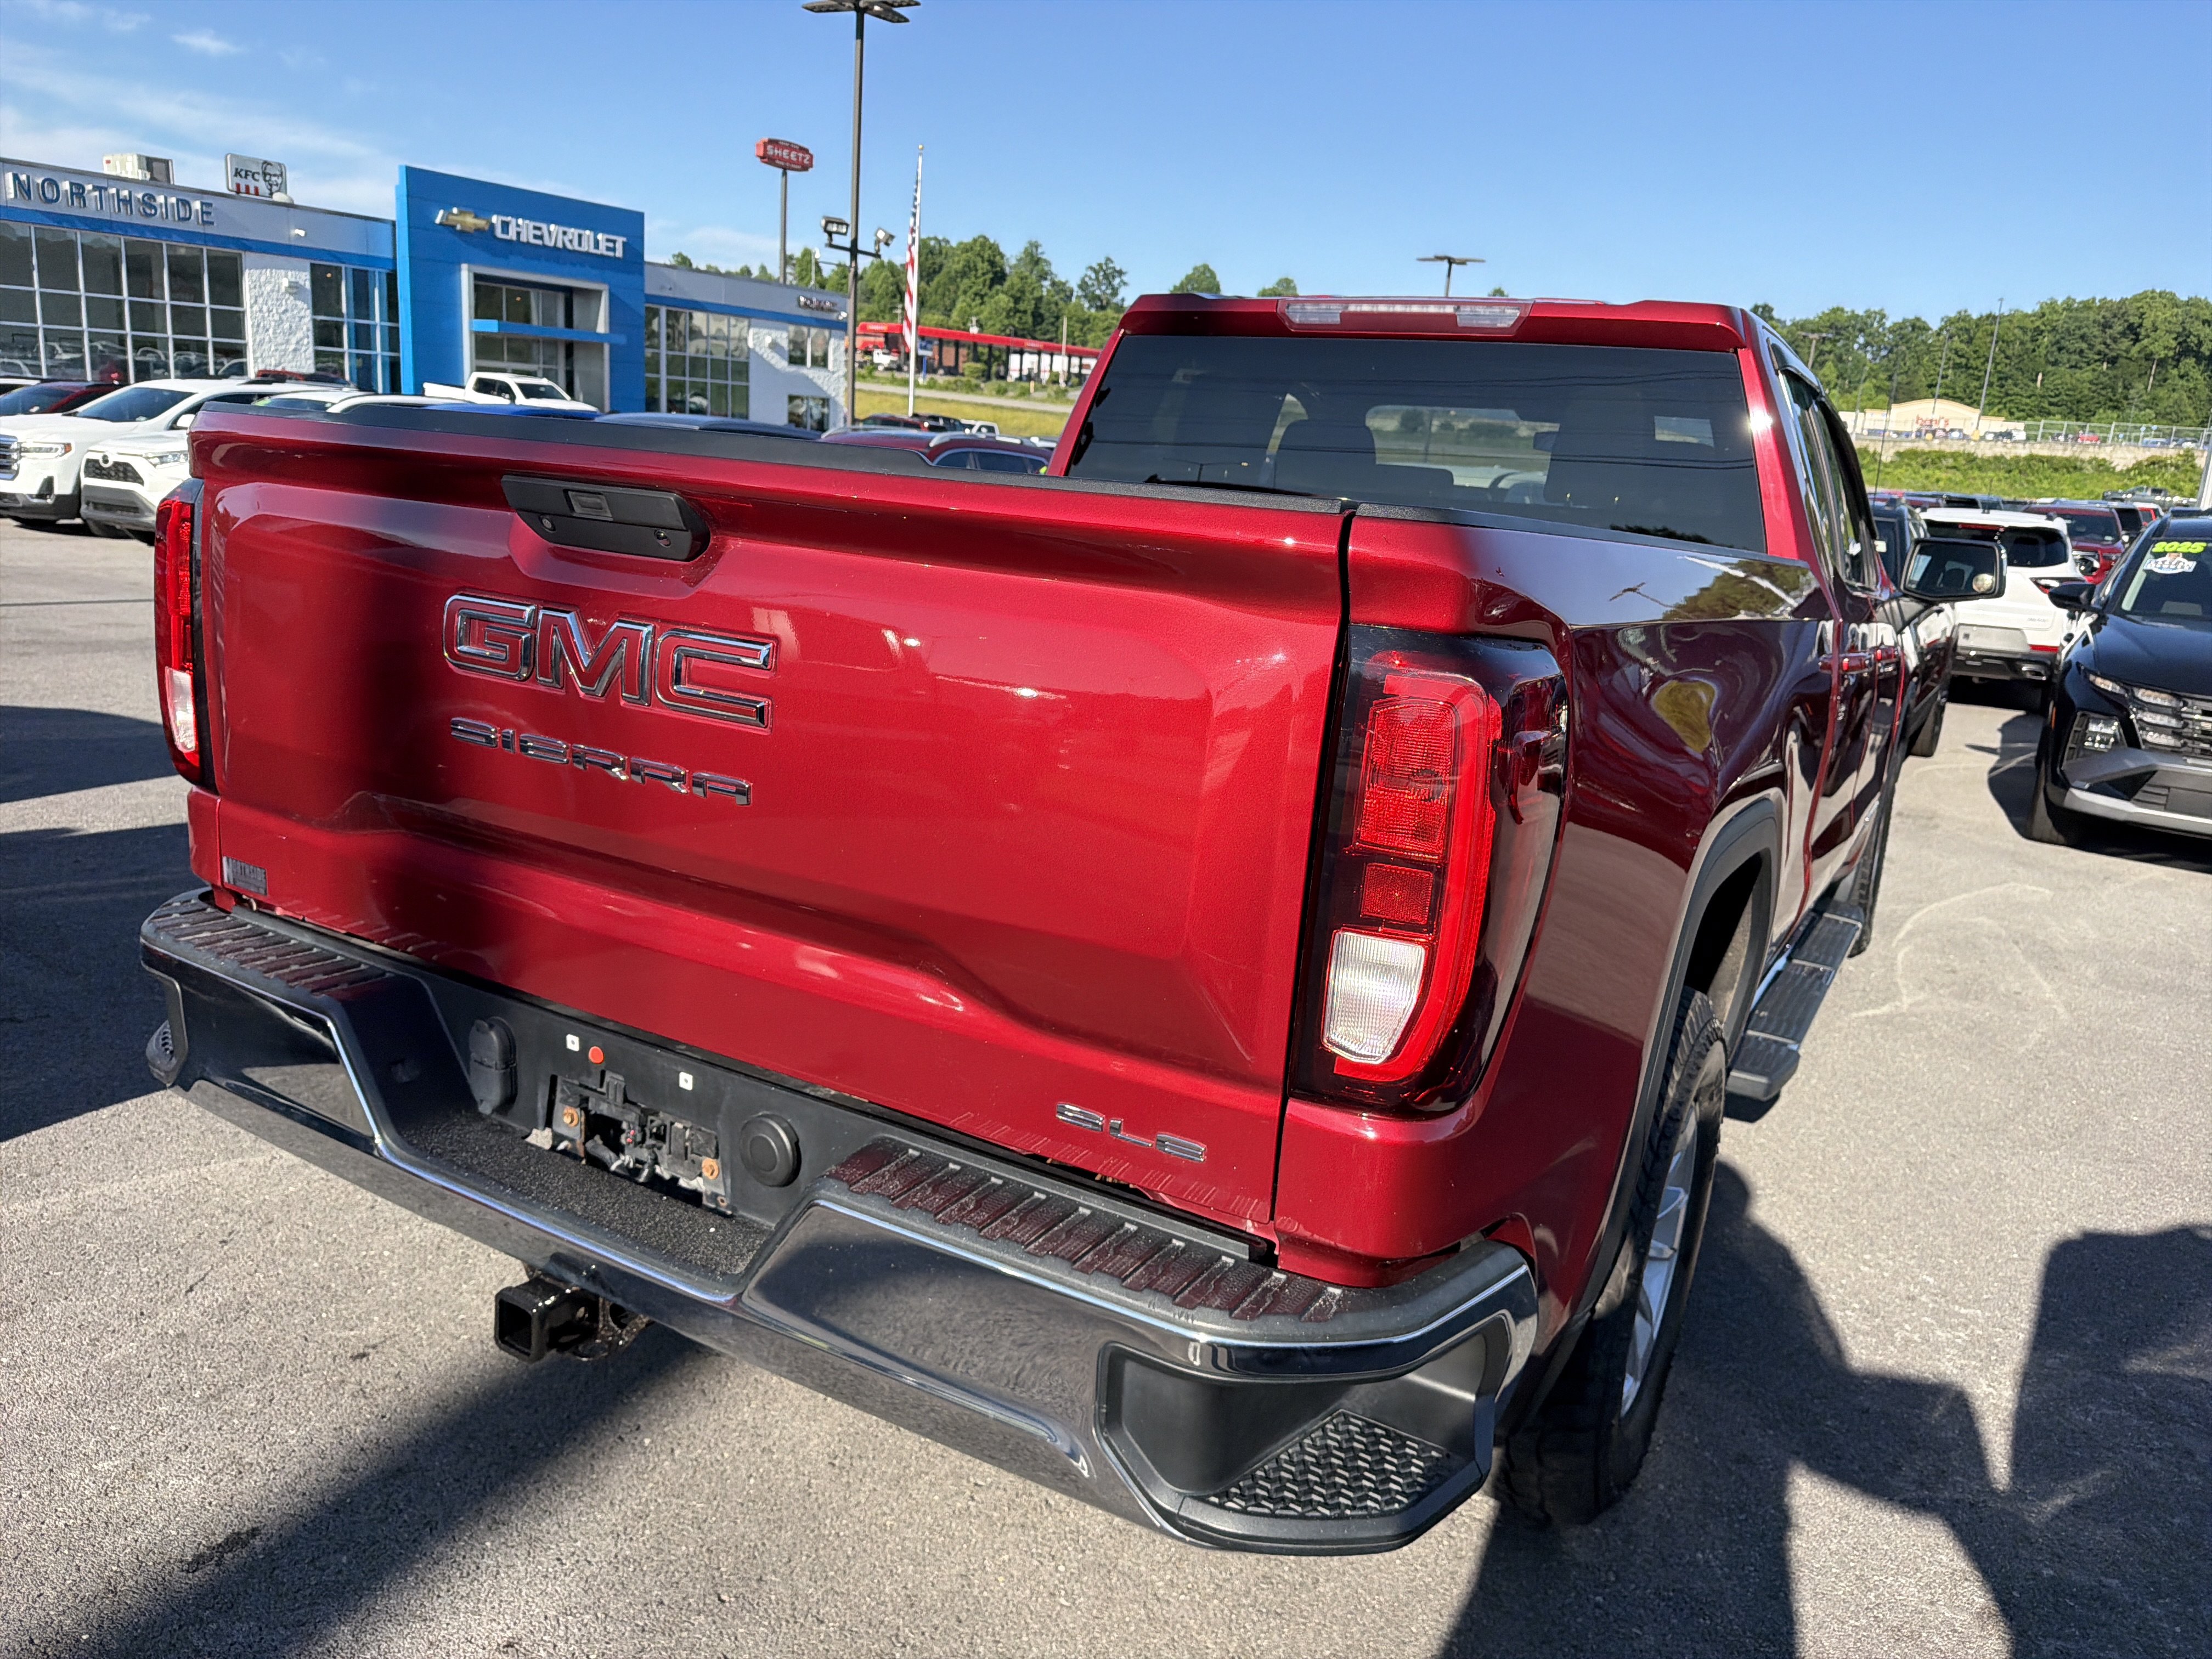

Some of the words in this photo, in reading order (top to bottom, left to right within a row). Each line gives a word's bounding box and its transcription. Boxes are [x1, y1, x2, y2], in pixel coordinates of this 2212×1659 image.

[234, 167, 260, 182] KFC
[766, 145, 810, 164] SHEETZ
[7, 172, 215, 225] NORTHSIDE
[492, 215, 627, 258] CHEVROLET
[2152, 541, 2207, 554] 2025
[443, 593, 775, 729] GMC
[450, 717, 752, 806] SIERRA
[1056, 1102, 1207, 1163] SLE
